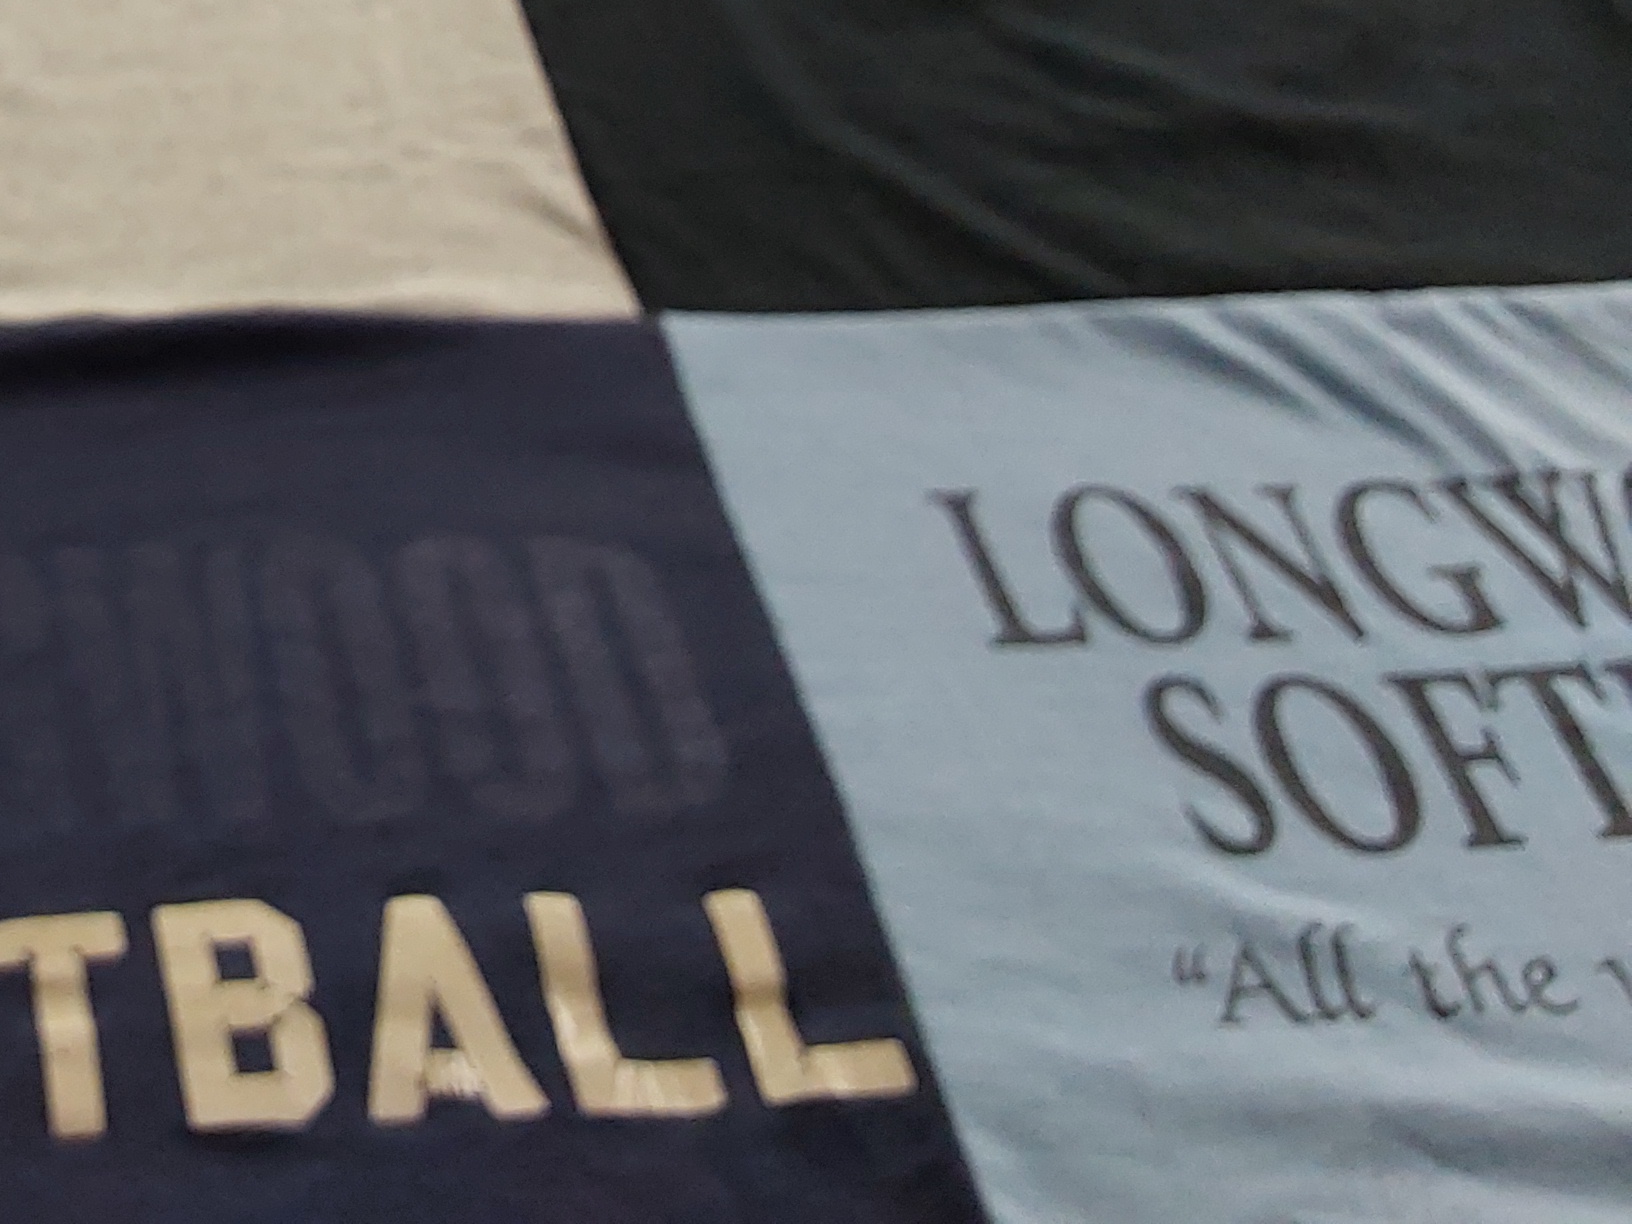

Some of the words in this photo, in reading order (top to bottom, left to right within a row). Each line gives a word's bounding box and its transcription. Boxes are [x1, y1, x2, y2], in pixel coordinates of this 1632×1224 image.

[924, 466, 1632, 646] LONGW
[1140, 658, 1632, 856] SOFT
[1404, 922, 1582, 1022] the
